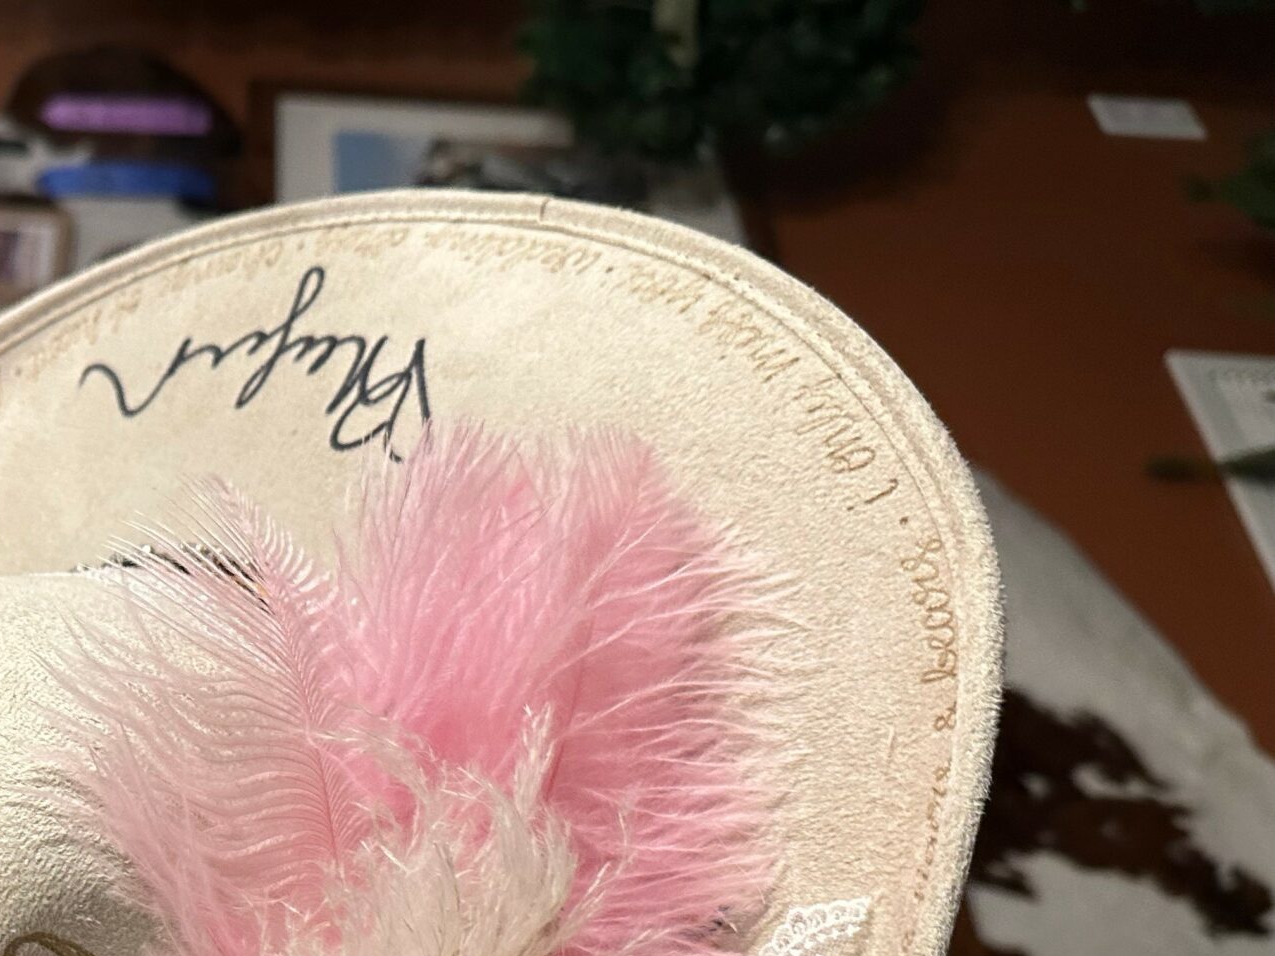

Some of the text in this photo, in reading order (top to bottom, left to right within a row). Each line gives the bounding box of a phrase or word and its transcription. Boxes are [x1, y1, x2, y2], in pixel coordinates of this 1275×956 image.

[697, 300, 802, 384] miss
[792, 374, 876, 475] only
[900, 538, 957, 686] bears
